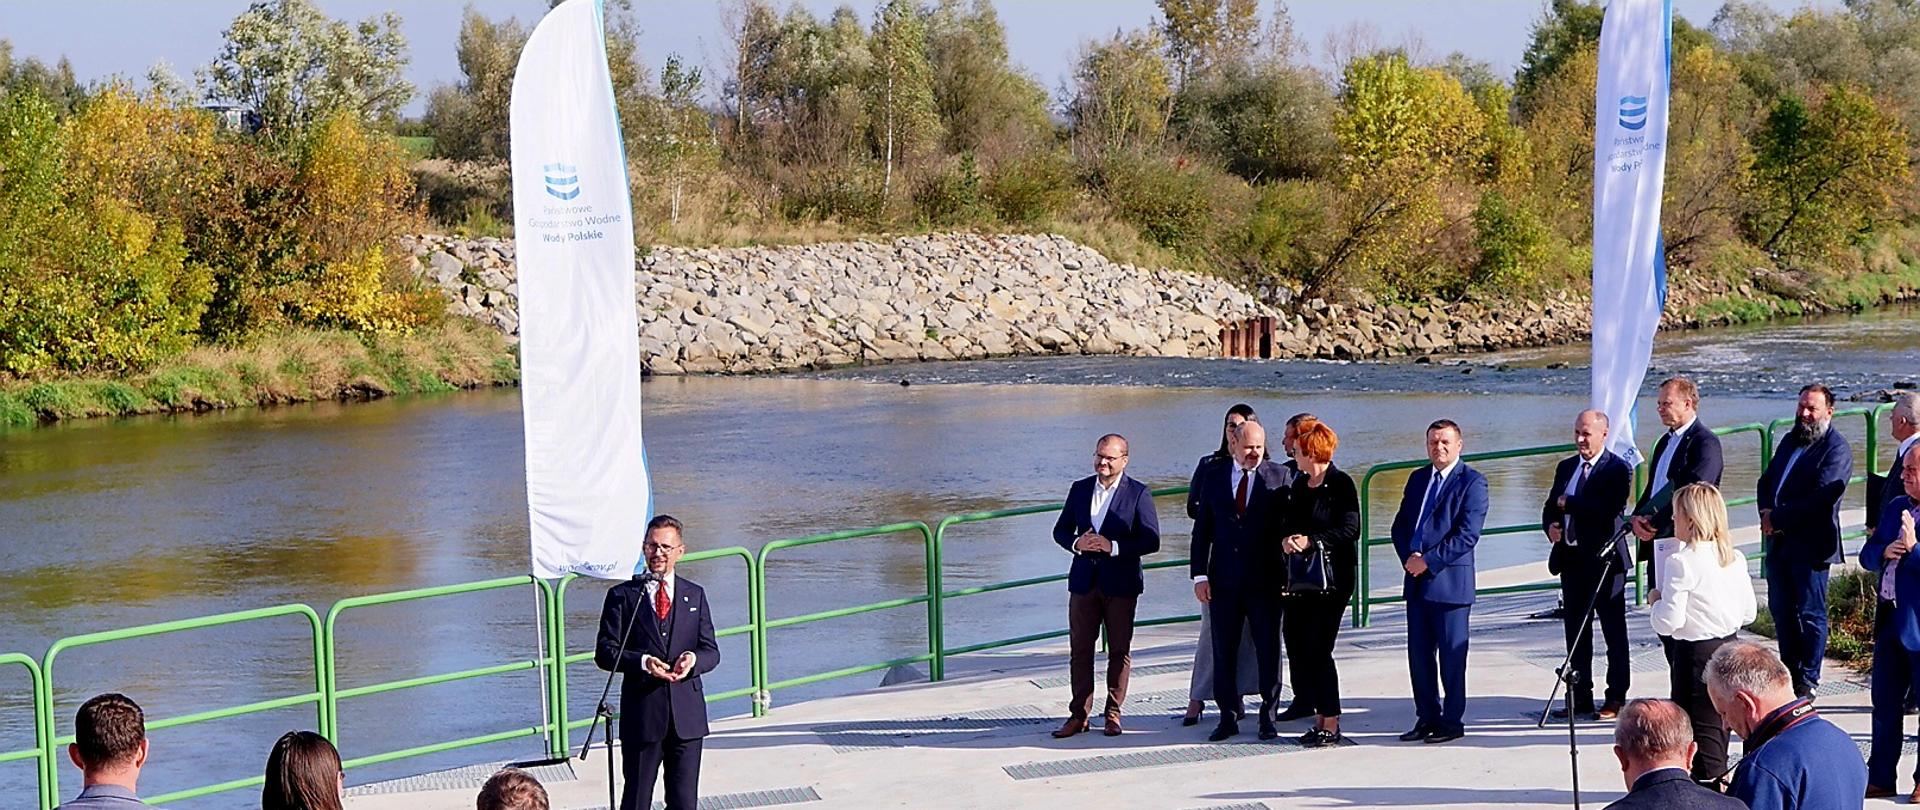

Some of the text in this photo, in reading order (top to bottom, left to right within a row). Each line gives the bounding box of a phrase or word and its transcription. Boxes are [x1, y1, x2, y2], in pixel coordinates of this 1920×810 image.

[584, 213, 621, 226] Wodne
[542, 229, 603, 244] Wody Polskie
